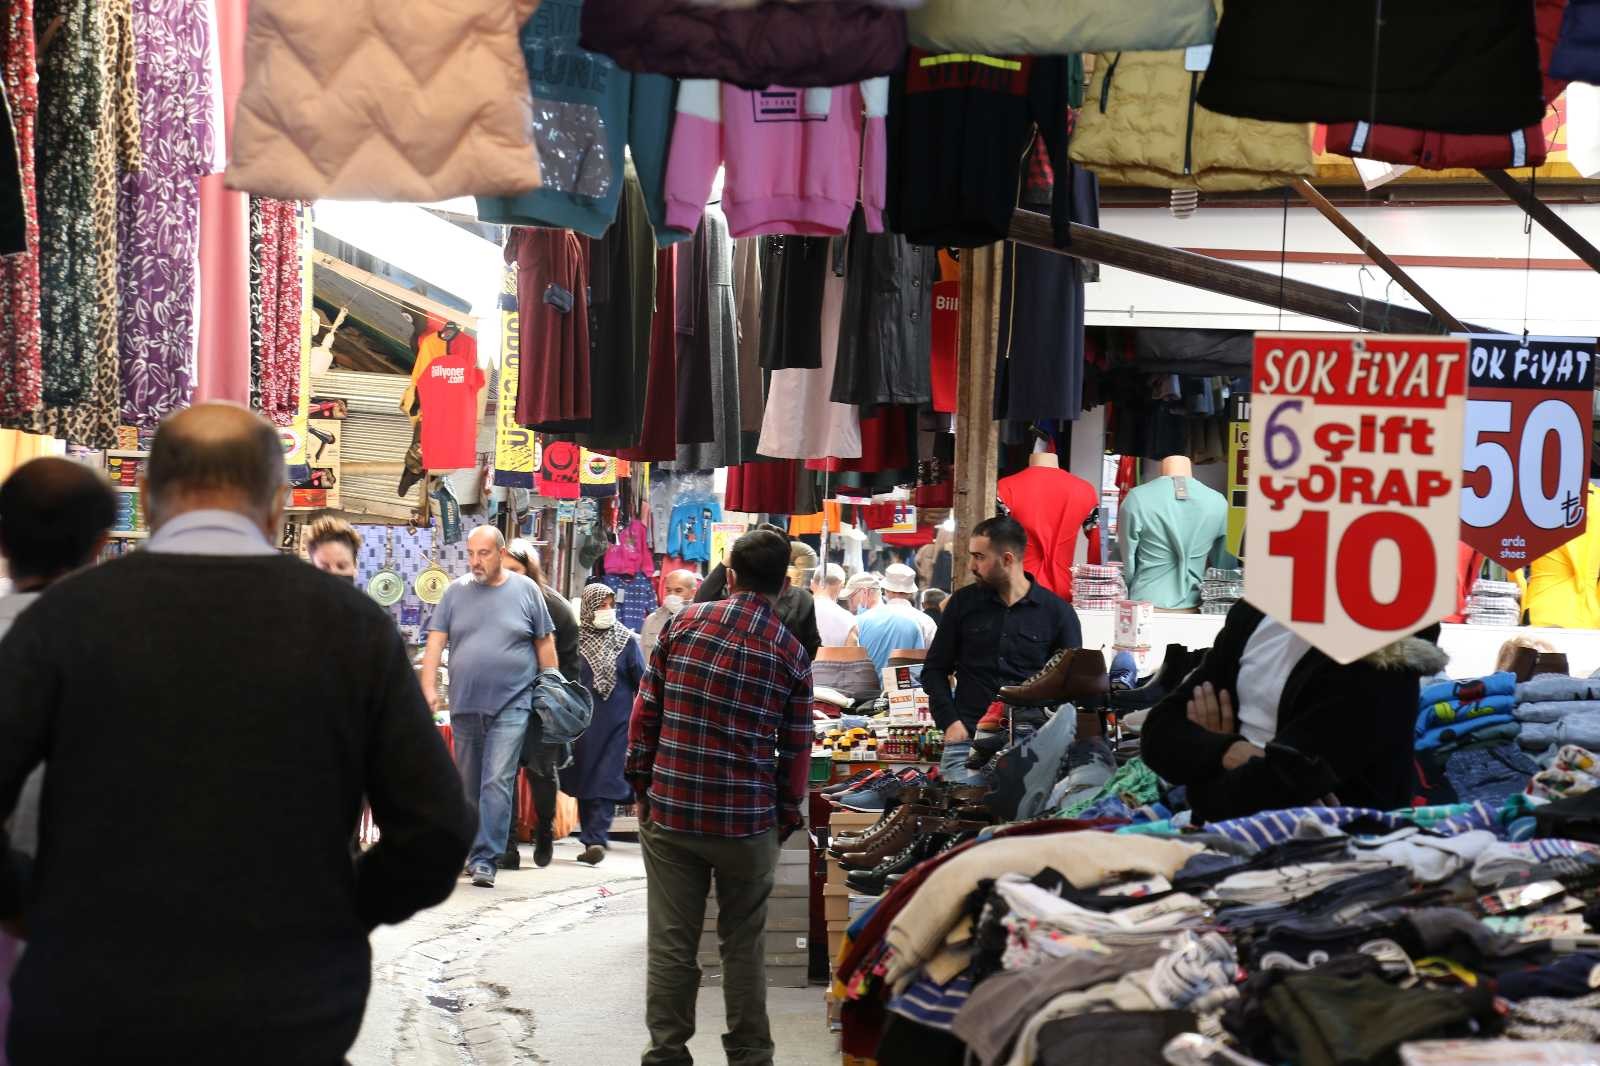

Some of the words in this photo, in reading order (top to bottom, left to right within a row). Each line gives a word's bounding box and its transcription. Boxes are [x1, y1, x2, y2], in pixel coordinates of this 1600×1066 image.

[936, 295, 959, 310] Bill
[1471, 346, 1506, 380] OK
[1264, 399, 1304, 471] 6
[1460, 398, 1585, 529] 50
[1259, 464, 1453, 511] ÇORAP
[1500, 547, 1527, 559] shoes
[1501, 535, 1526, 547] arda
[1268, 508, 1438, 632] 10
